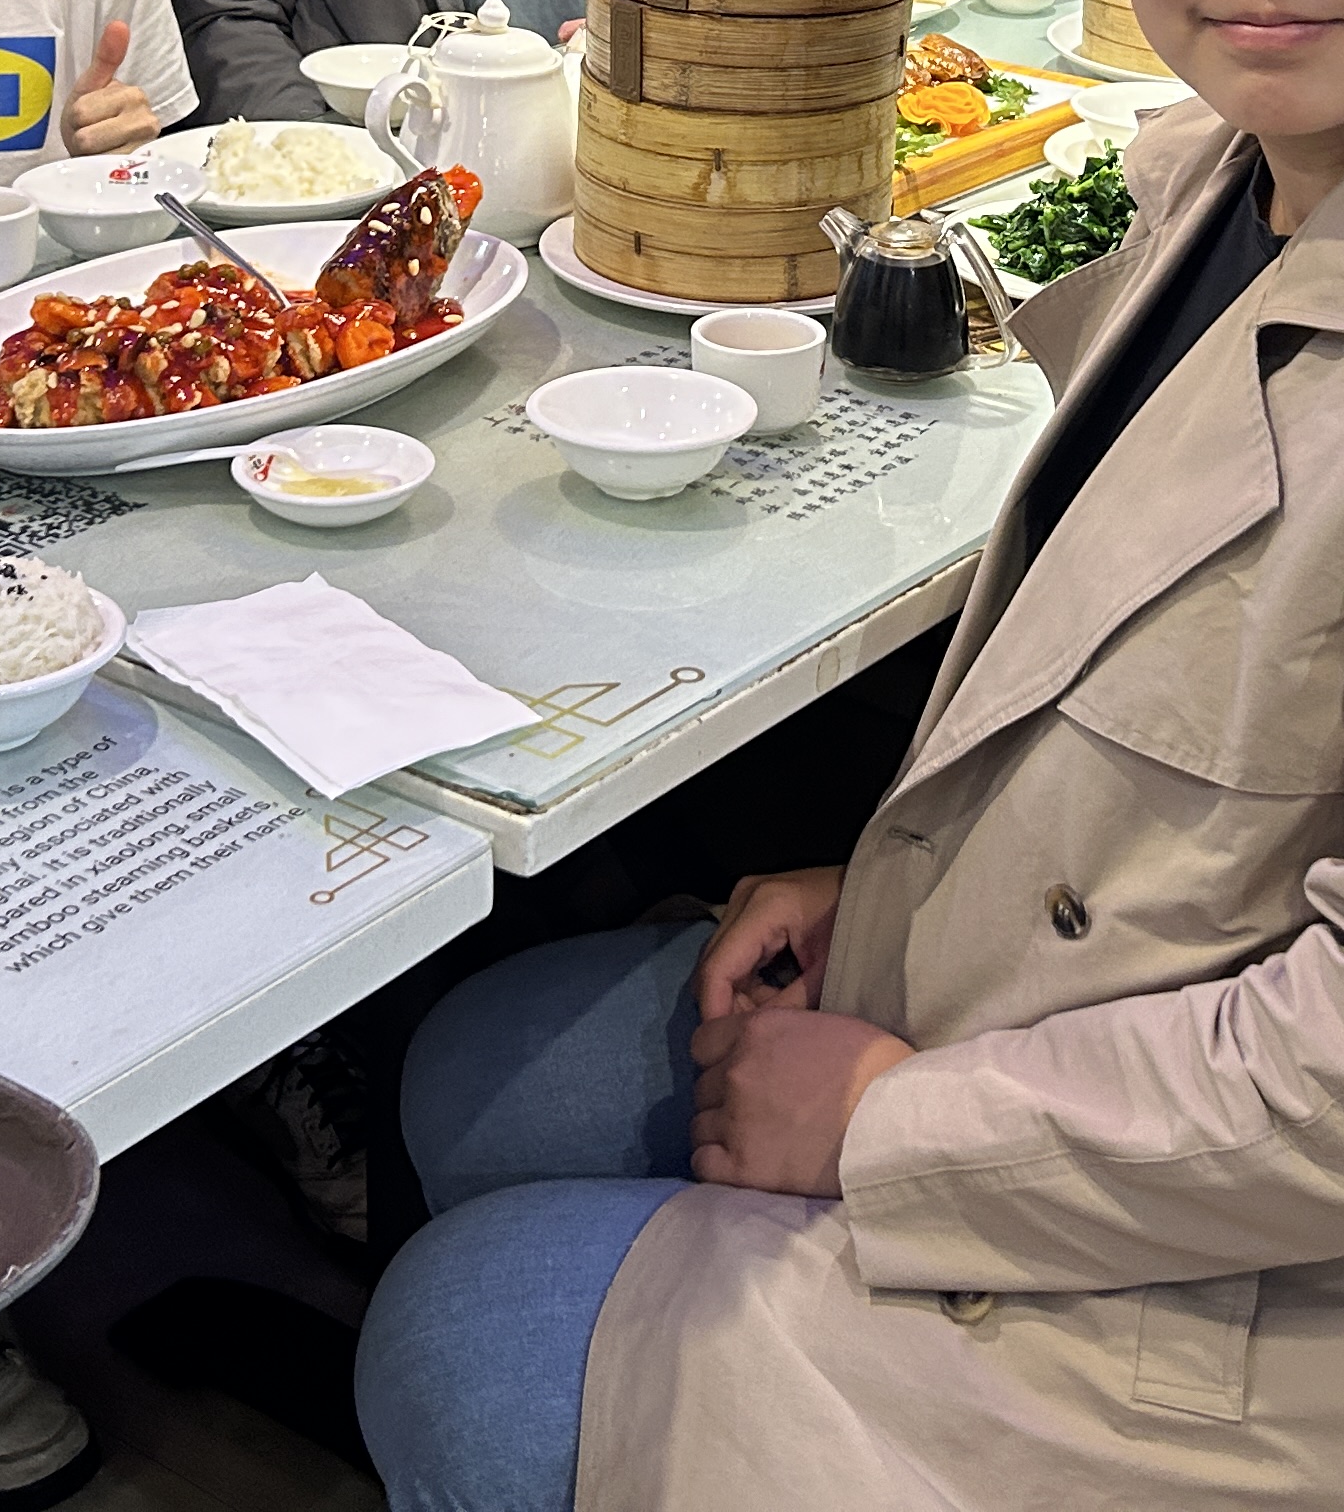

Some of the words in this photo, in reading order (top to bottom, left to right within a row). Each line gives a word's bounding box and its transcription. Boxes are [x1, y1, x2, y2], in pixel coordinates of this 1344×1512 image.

[0, 781, 26, 799] is
[25, 775, 45, 787] a
[41, 749, 93, 775] type
[93, 735, 119, 753] of
[0, 788, 63, 819] from
[58, 768, 100, 790] the
[62, 796, 89, 814] of
[86, 765, 160, 800] China,
[21, 792, 143, 861] associated
[140, 768, 192, 796] with
[42, 855, 70, 873] It
[66, 844, 92, 861] is
[88, 778, 218, 849] traditionally
[54, 871, 88, 890] in
[186, 786, 248, 821] small
[81, 843, 190, 906] steaming
[185, 798, 280, 850] baskets,
[5, 928, 82, 974] which
[81, 901, 133, 935] give
[128, 867, 195, 905] them
[189, 838, 245, 872] their
[243, 805, 312, 843] name.
